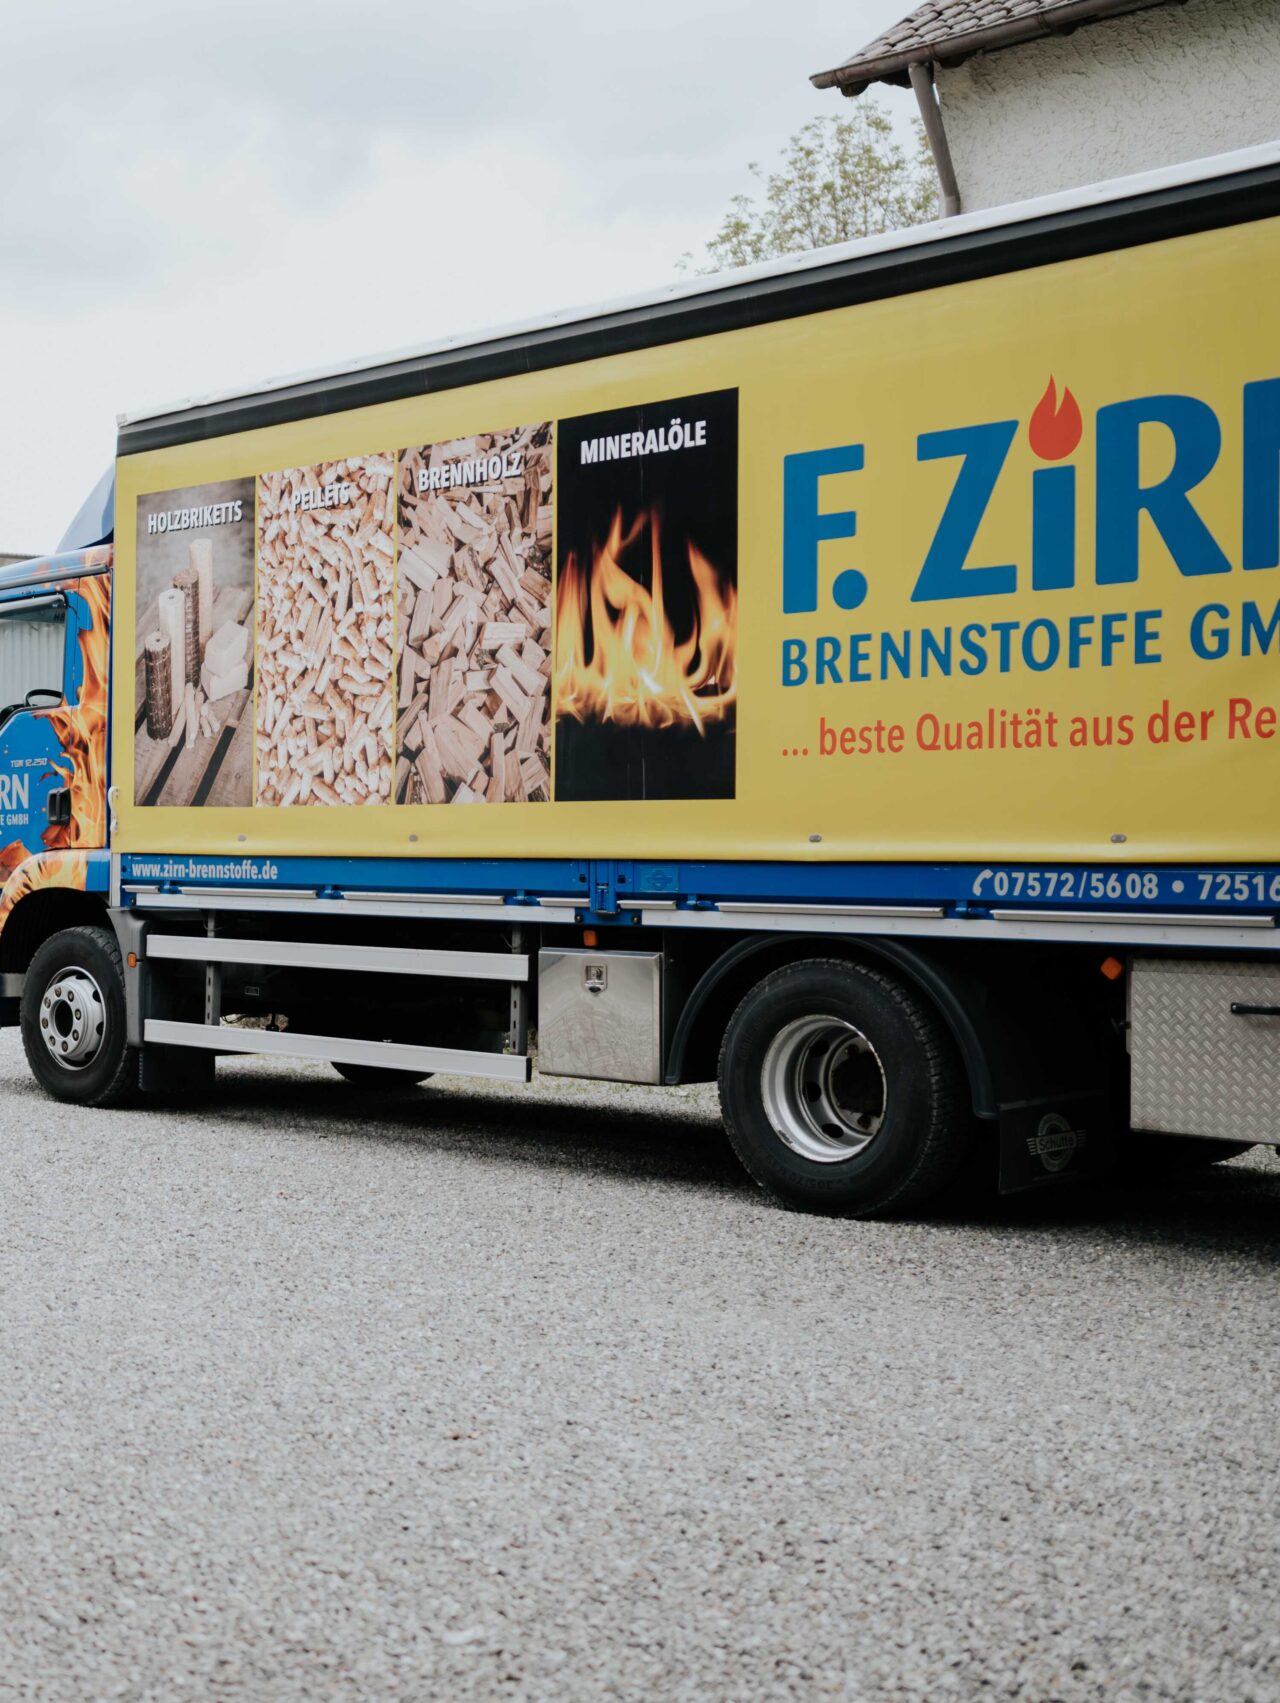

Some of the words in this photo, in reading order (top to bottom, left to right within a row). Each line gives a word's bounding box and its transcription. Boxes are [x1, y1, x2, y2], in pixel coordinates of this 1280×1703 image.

[580, 418, 707, 465] MINERALÖLE
[418, 453, 521, 492] BRENNHOLZ
[147, 499, 243, 535] HOLZBRIKETTS
[291, 482, 350, 513] PELLETS
[782, 443, 868, 615] F.
[781, 609, 1163, 687] BRENNSTOFFE
[819, 717, 905, 756] beste
[916, 708, 1058, 752] Qualität
[1069, 713, 1135, 747] aus
[1147, 699, 1215, 744] der
[1228, 697, 1277, 740] Re
[6, 813, 29, 826] GMBH
[132, 859, 278, 880] www.zirn-brennstoffe.de
